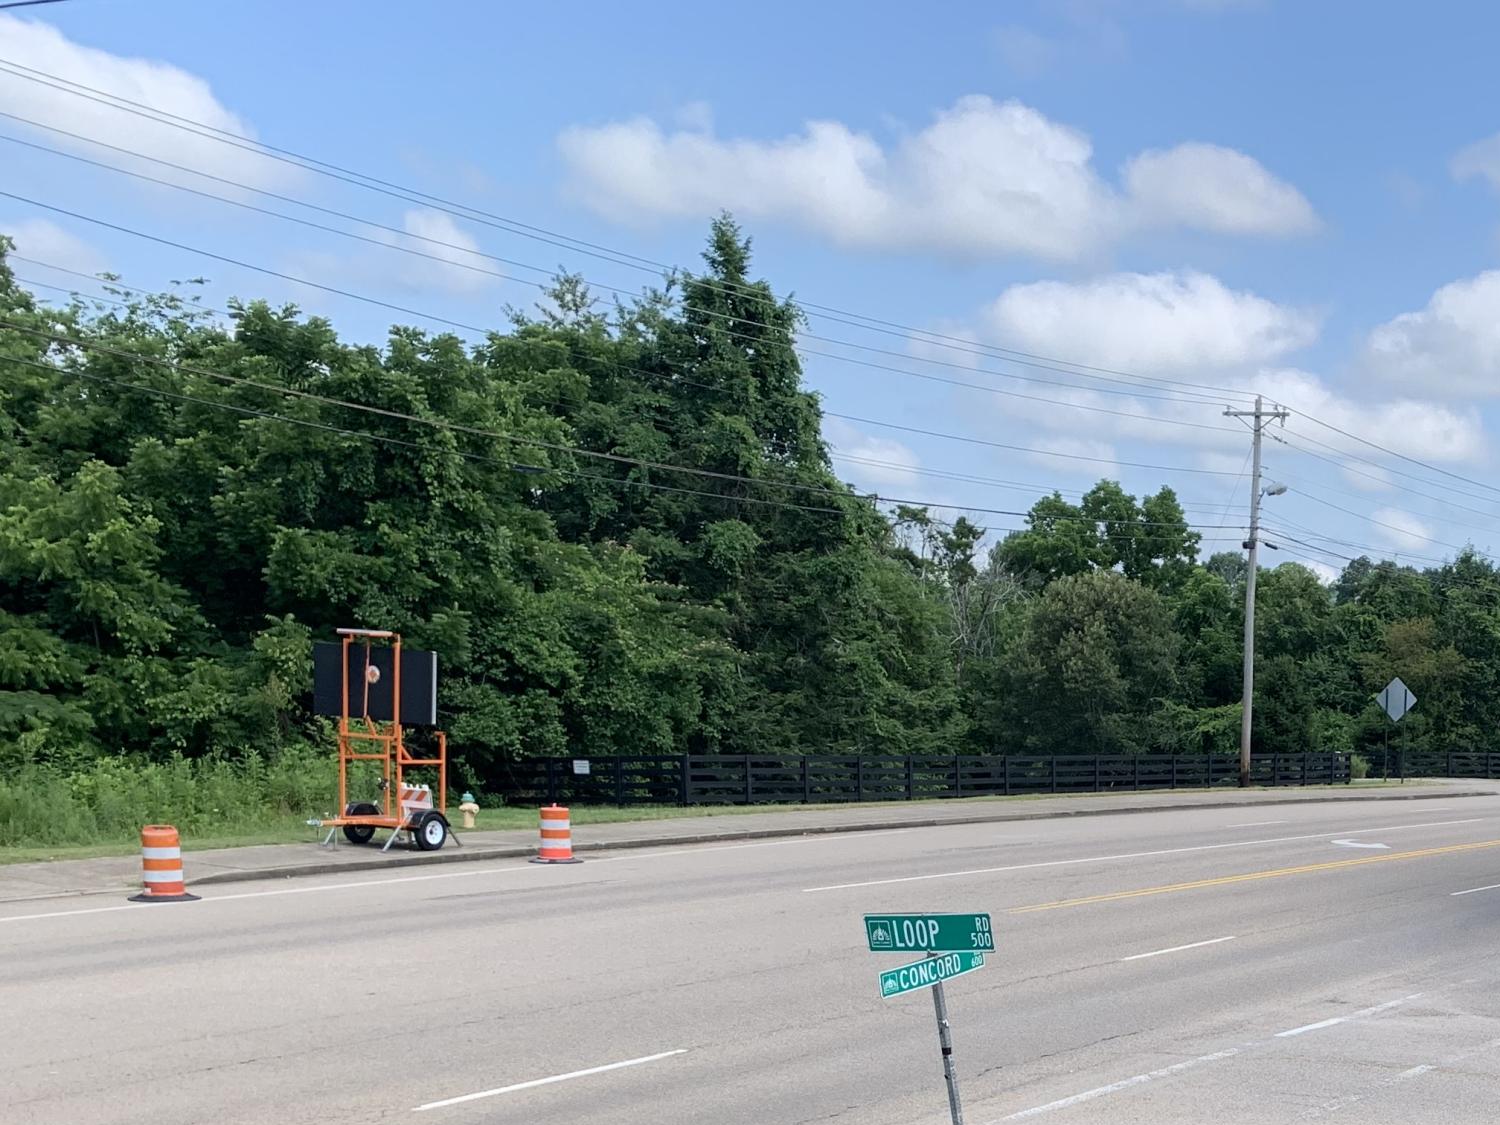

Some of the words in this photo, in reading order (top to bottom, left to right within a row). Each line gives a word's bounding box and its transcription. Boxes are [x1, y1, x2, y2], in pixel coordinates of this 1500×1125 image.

[892, 919, 940, 947] LOOP
[975, 917, 989, 932] RD
[970, 932, 991, 947] 500
[900, 953, 961, 989] CONCORD
